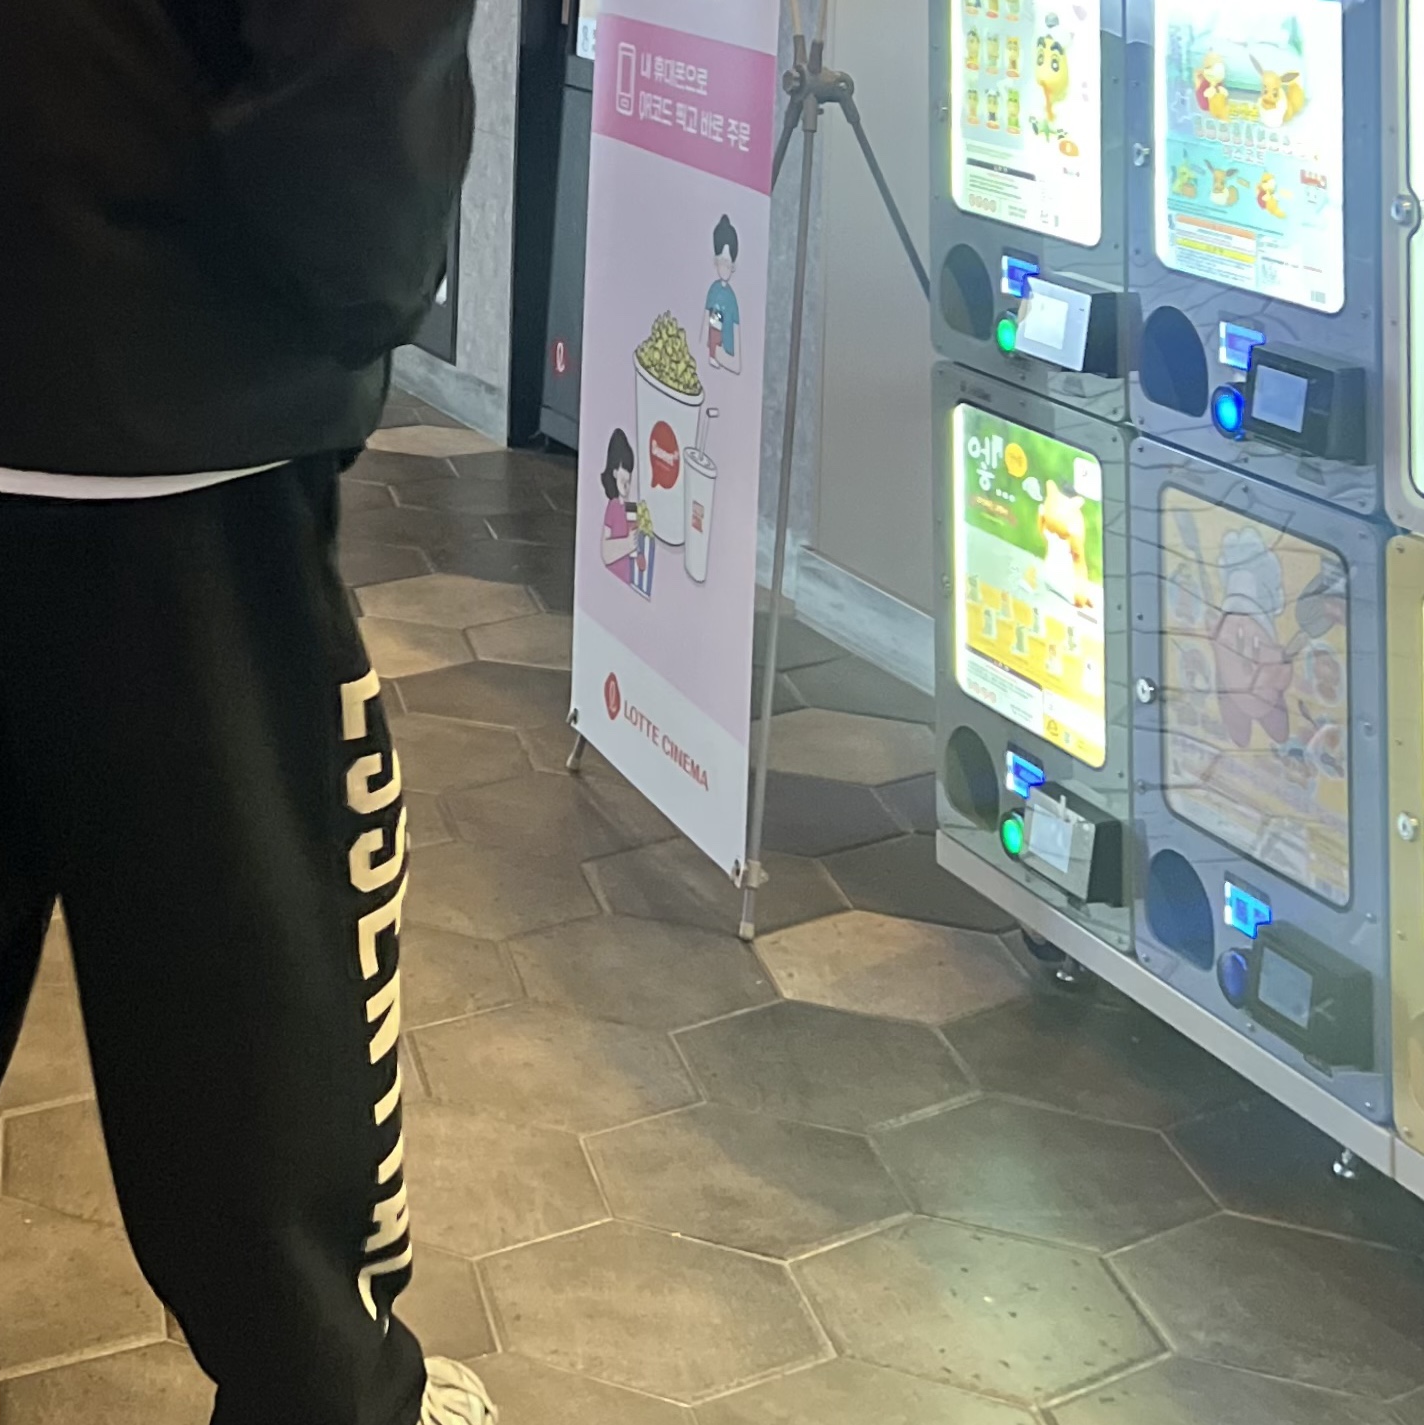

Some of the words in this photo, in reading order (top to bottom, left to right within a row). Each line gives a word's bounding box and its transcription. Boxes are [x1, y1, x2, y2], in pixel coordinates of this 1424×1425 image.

[640, 53, 651, 79] 내
[654, 56, 708, 95] 휴대폰으로
[701, 111, 724, 143] 바로
[727, 118, 751, 152] 주문
[623, 699, 660, 747] LOTTE
[662, 734, 709, 792] CINEMA
